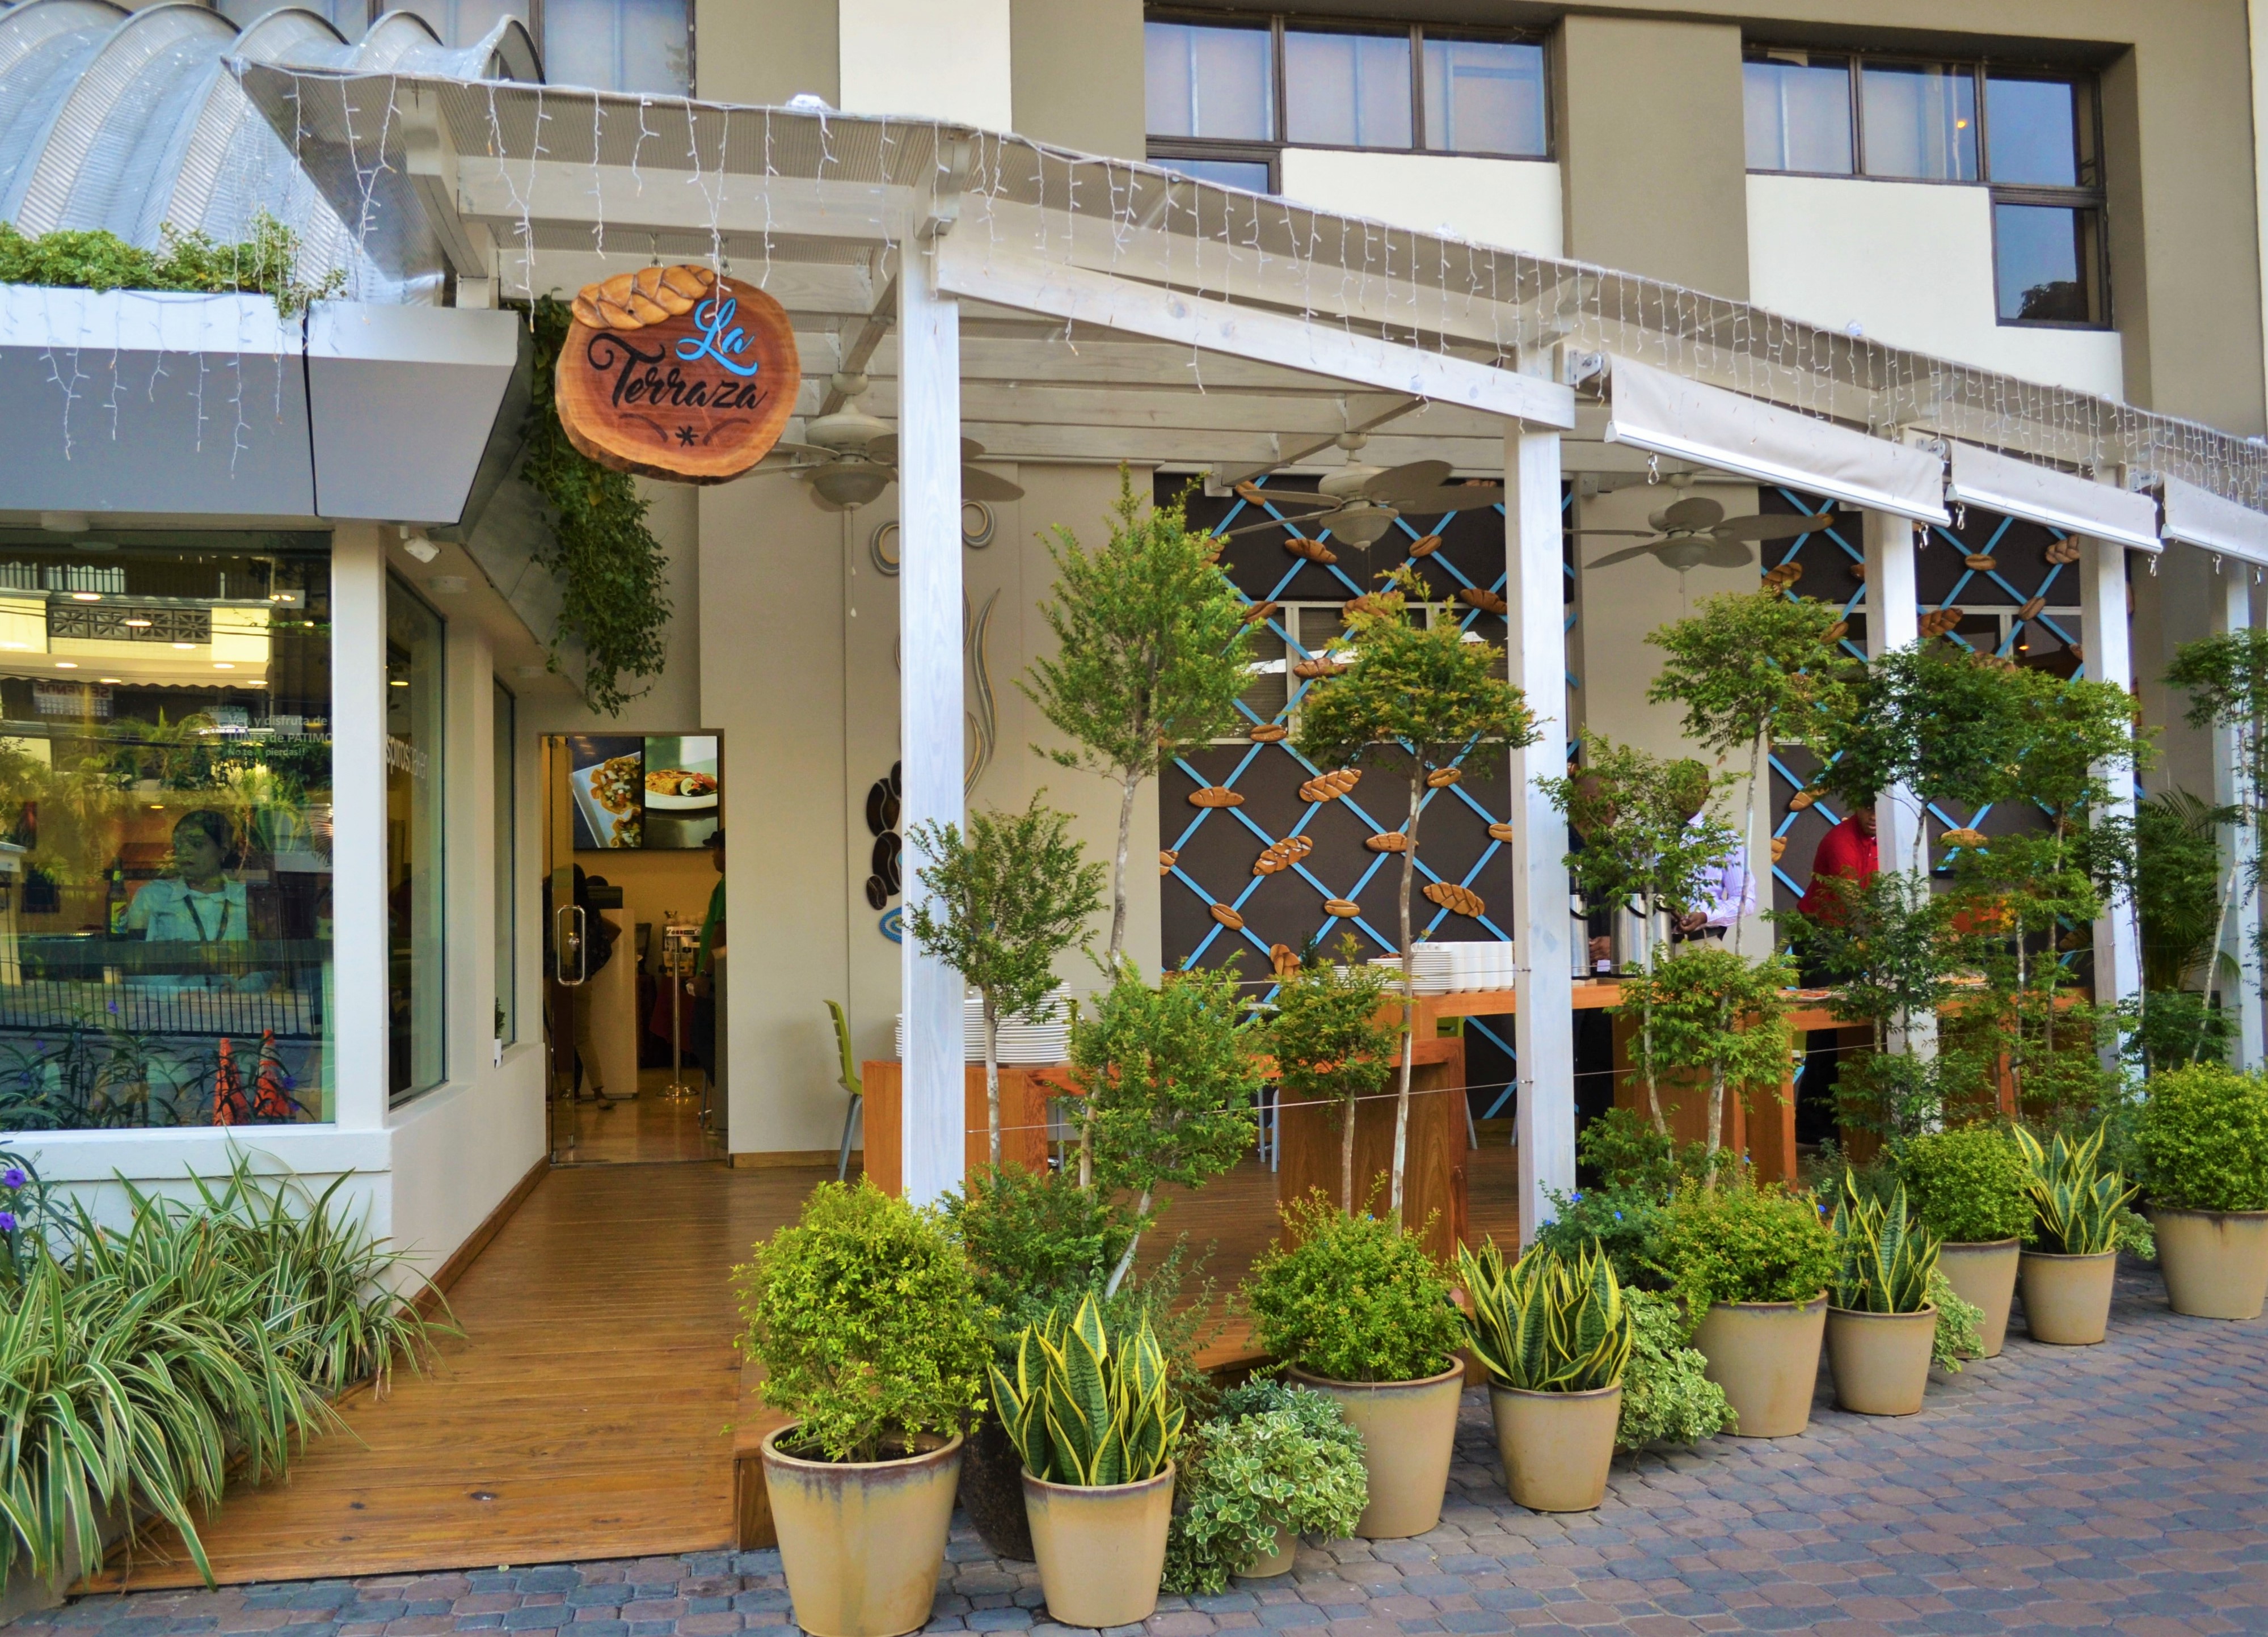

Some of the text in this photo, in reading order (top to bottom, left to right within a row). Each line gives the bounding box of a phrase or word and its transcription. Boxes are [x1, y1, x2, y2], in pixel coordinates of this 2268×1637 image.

[676, 298, 758, 377] La
[588, 332, 767, 409] Terraza
[254, 718, 261, 728] y
[264, 715, 310, 725] disfruta
[313, 715, 328, 725] de
[269, 732, 284, 743] de
[265, 748, 305, 757] pierdas!!
